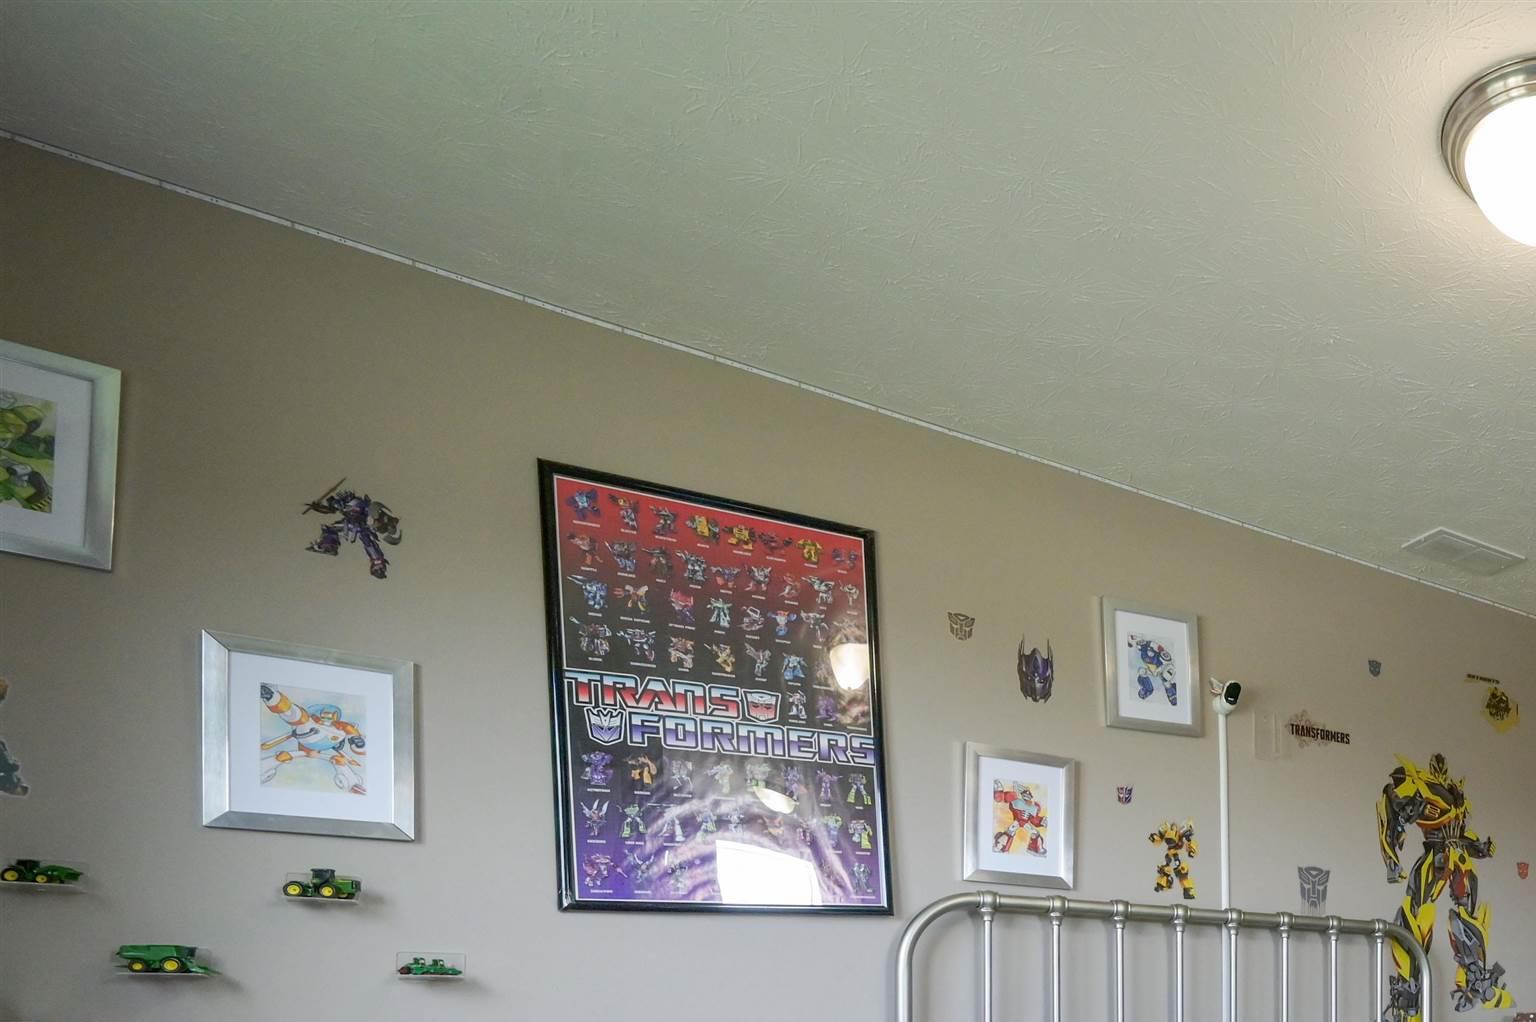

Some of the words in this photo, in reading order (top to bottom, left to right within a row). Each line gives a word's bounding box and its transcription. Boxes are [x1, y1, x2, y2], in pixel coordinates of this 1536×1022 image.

[564, 669, 742, 721] TRANS
[628, 711, 875, 767] FORMERS
[1290, 723, 1351, 744] TRANSFORMERS
